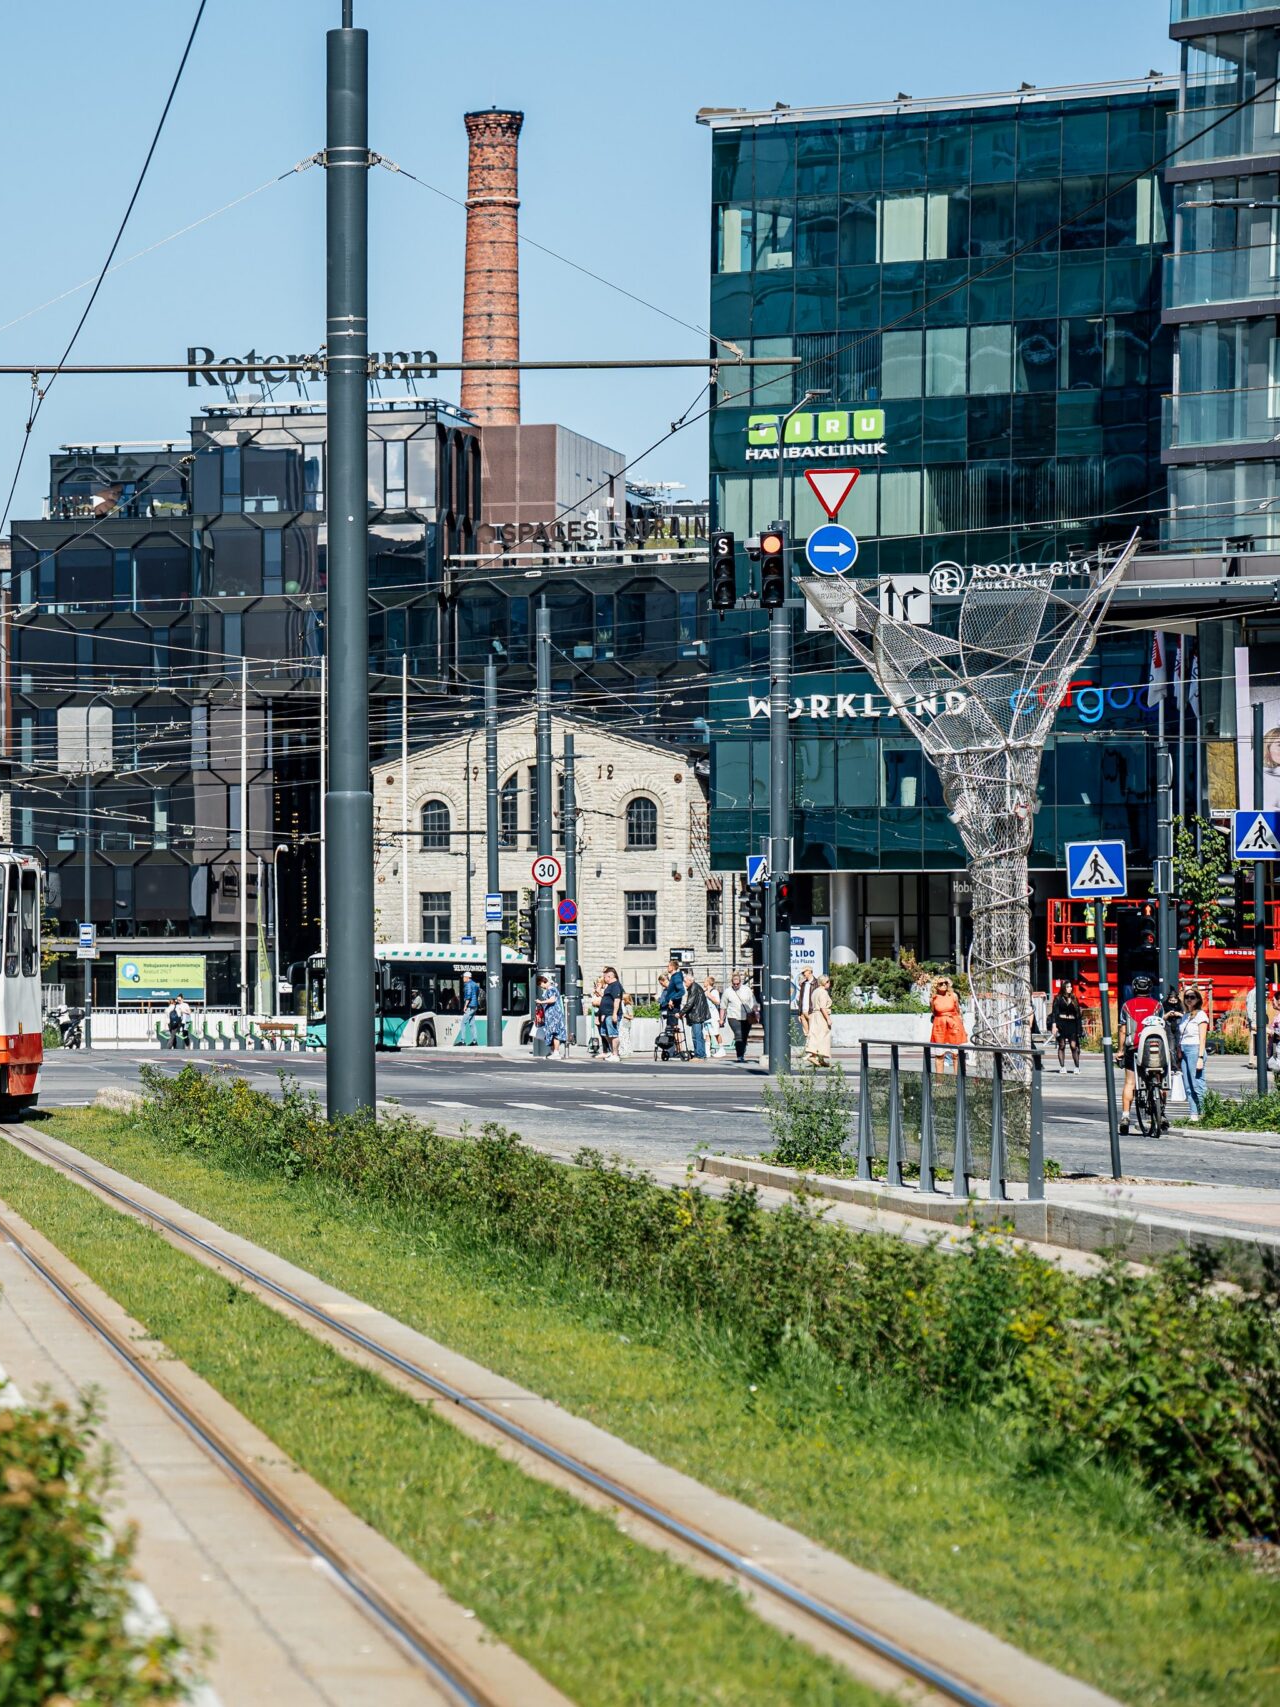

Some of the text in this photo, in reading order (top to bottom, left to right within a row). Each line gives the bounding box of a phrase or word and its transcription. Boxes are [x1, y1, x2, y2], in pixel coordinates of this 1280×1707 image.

[745, 443, 888, 460] HAMBAKLIINIK
[501, 520, 599, 544] SPACES
[624, 515, 707, 543] SORAIN
[718, 538, 729, 554] S
[972, 561, 1091, 578] ROYAL GRA
[538, 863, 555, 878] 30
[952, 880, 974, 893] Hobu
[795, 950, 816, 958] LIDO
